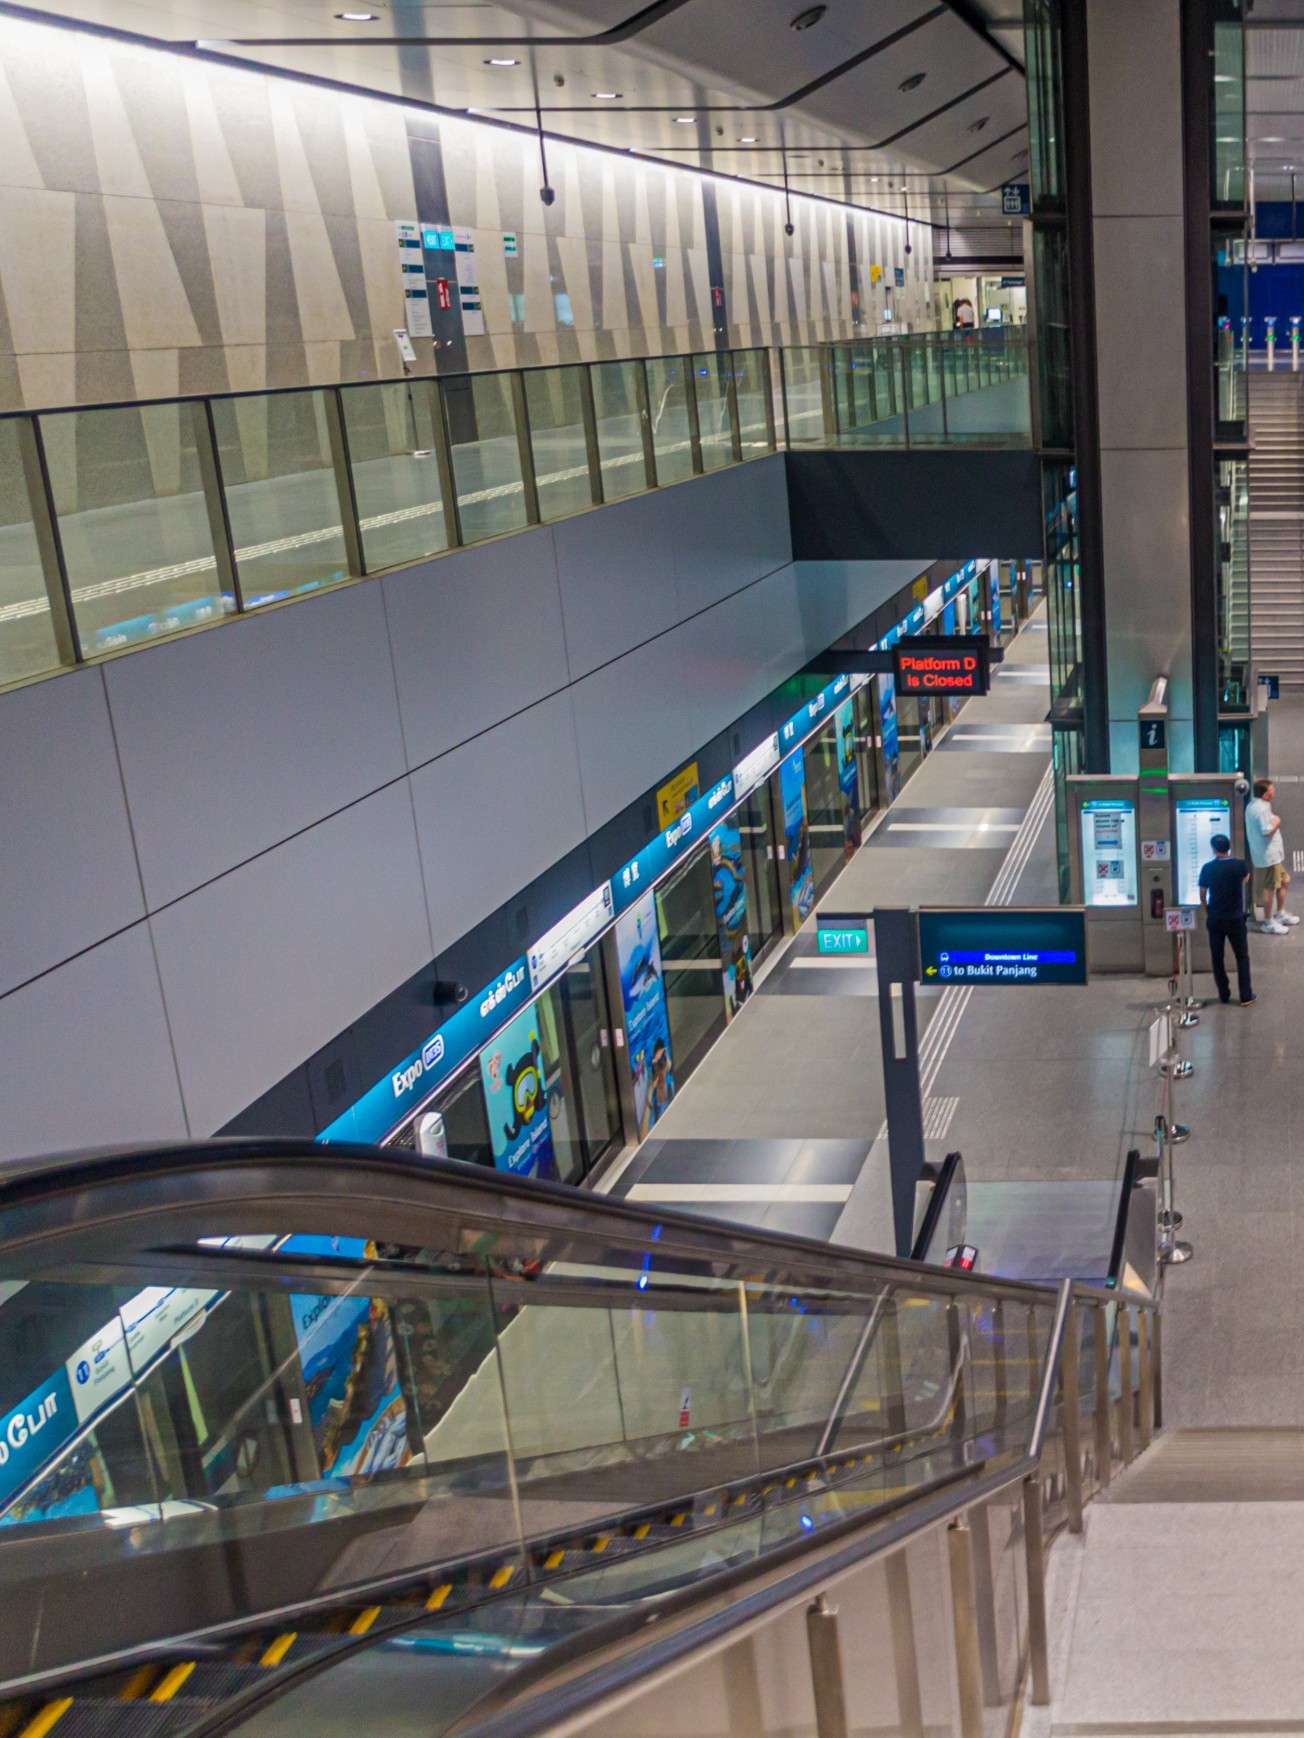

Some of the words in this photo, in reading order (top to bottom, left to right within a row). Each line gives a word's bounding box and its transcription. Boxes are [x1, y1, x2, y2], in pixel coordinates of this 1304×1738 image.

[899, 656, 961, 671] Platform
[963, 656, 977, 671] D
[906, 674, 920, 688] is
[923, 673, 973, 688] Closed
[823, 933, 853, 949] EXIT
[984, 953, 1021, 961] Downtown
[1022, 953, 1038, 961] Line
[953, 966, 965, 976] to
[966, 965, 994, 976] Bukit
[995, 965, 1037, 979] Panjang
[391, 1059, 423, 1098] Expo
